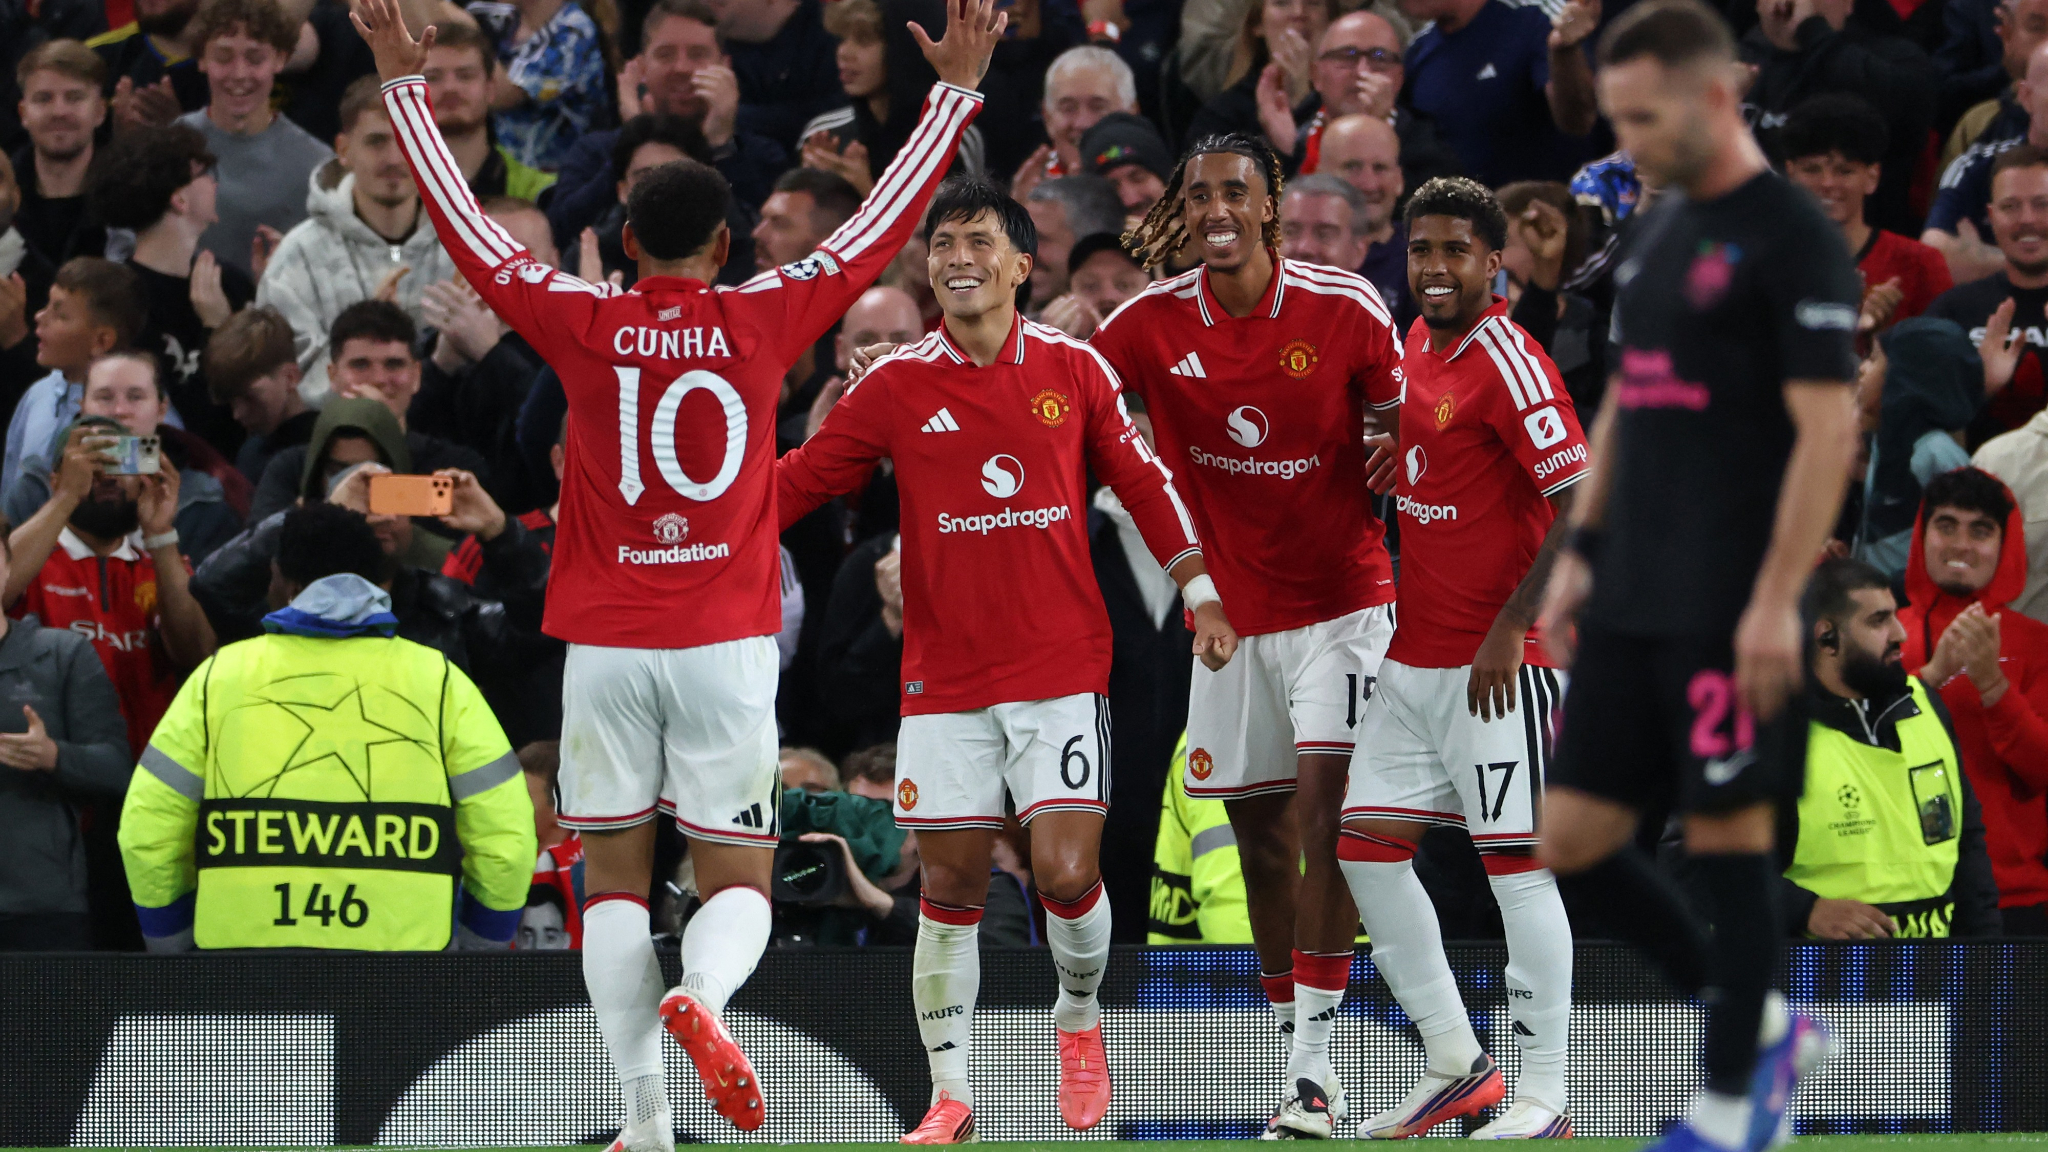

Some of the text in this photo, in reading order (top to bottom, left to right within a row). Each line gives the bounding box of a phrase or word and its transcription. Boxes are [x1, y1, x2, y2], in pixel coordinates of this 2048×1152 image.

[657, 305, 682, 322] UNITED
[613, 325, 732, 360] CUNHA
[612, 365, 748, 507] 10
[1189, 445, 1321, 480] Snapdragon
[937, 504, 1072, 536] Snapdragon
[1396, 494, 1457, 525] dragon
[617, 542, 730, 565] Foundation
[1060, 734, 1091, 790] 6
[1474, 760, 1520, 824] 17
[207, 809, 440, 860] STEWARD
[273, 882, 369, 928] 146
[921, 1004, 964, 1022] MUFC
